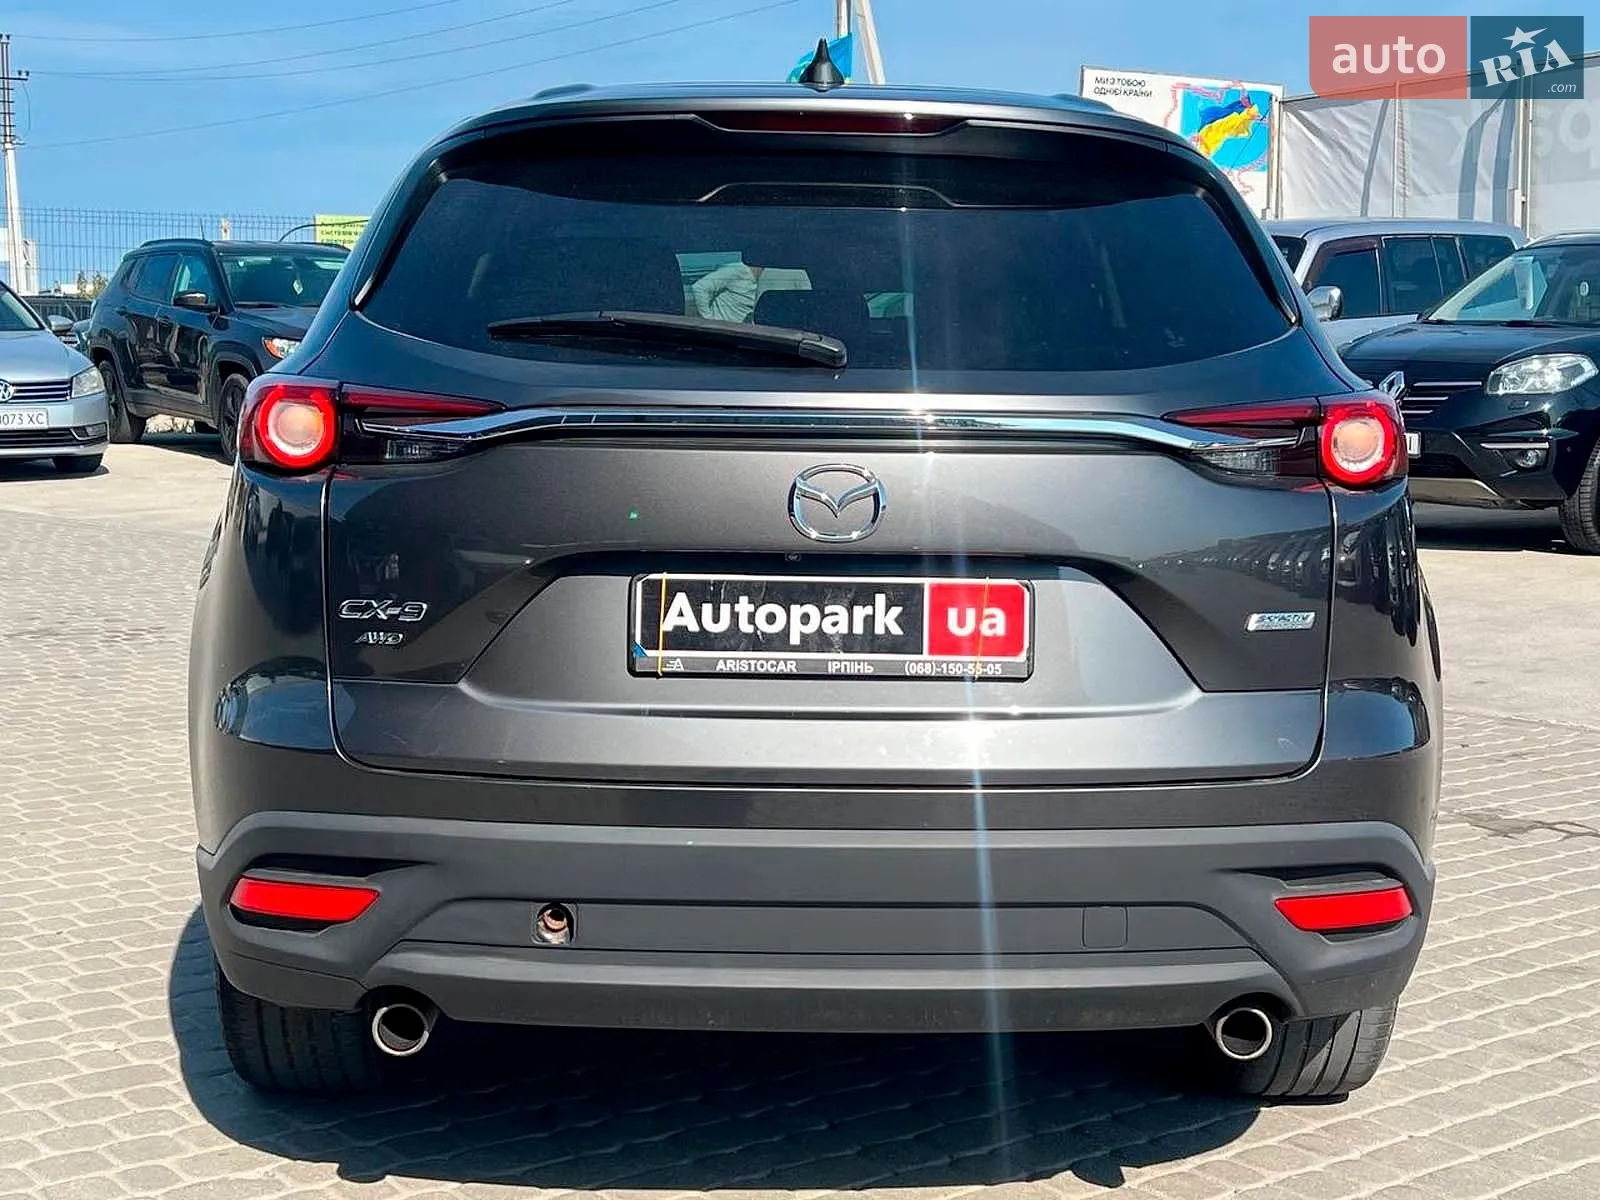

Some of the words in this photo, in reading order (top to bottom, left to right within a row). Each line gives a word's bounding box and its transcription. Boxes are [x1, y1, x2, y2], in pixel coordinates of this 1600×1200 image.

[1117, 78, 1146, 87] ТОБОЮ
[1093, 86, 1122, 96] ОДНІЄЇ
[0, 413, 24, 425] 073
[338, 599, 428, 622] CX-9
[662, 591, 904, 645] Autopark
[947, 606, 1008, 637] ua
[354, 631, 404, 645] AWD
[715, 659, 797, 673] ARISTOCAR
[827, 660, 874, 674] ІРПІНЬ
